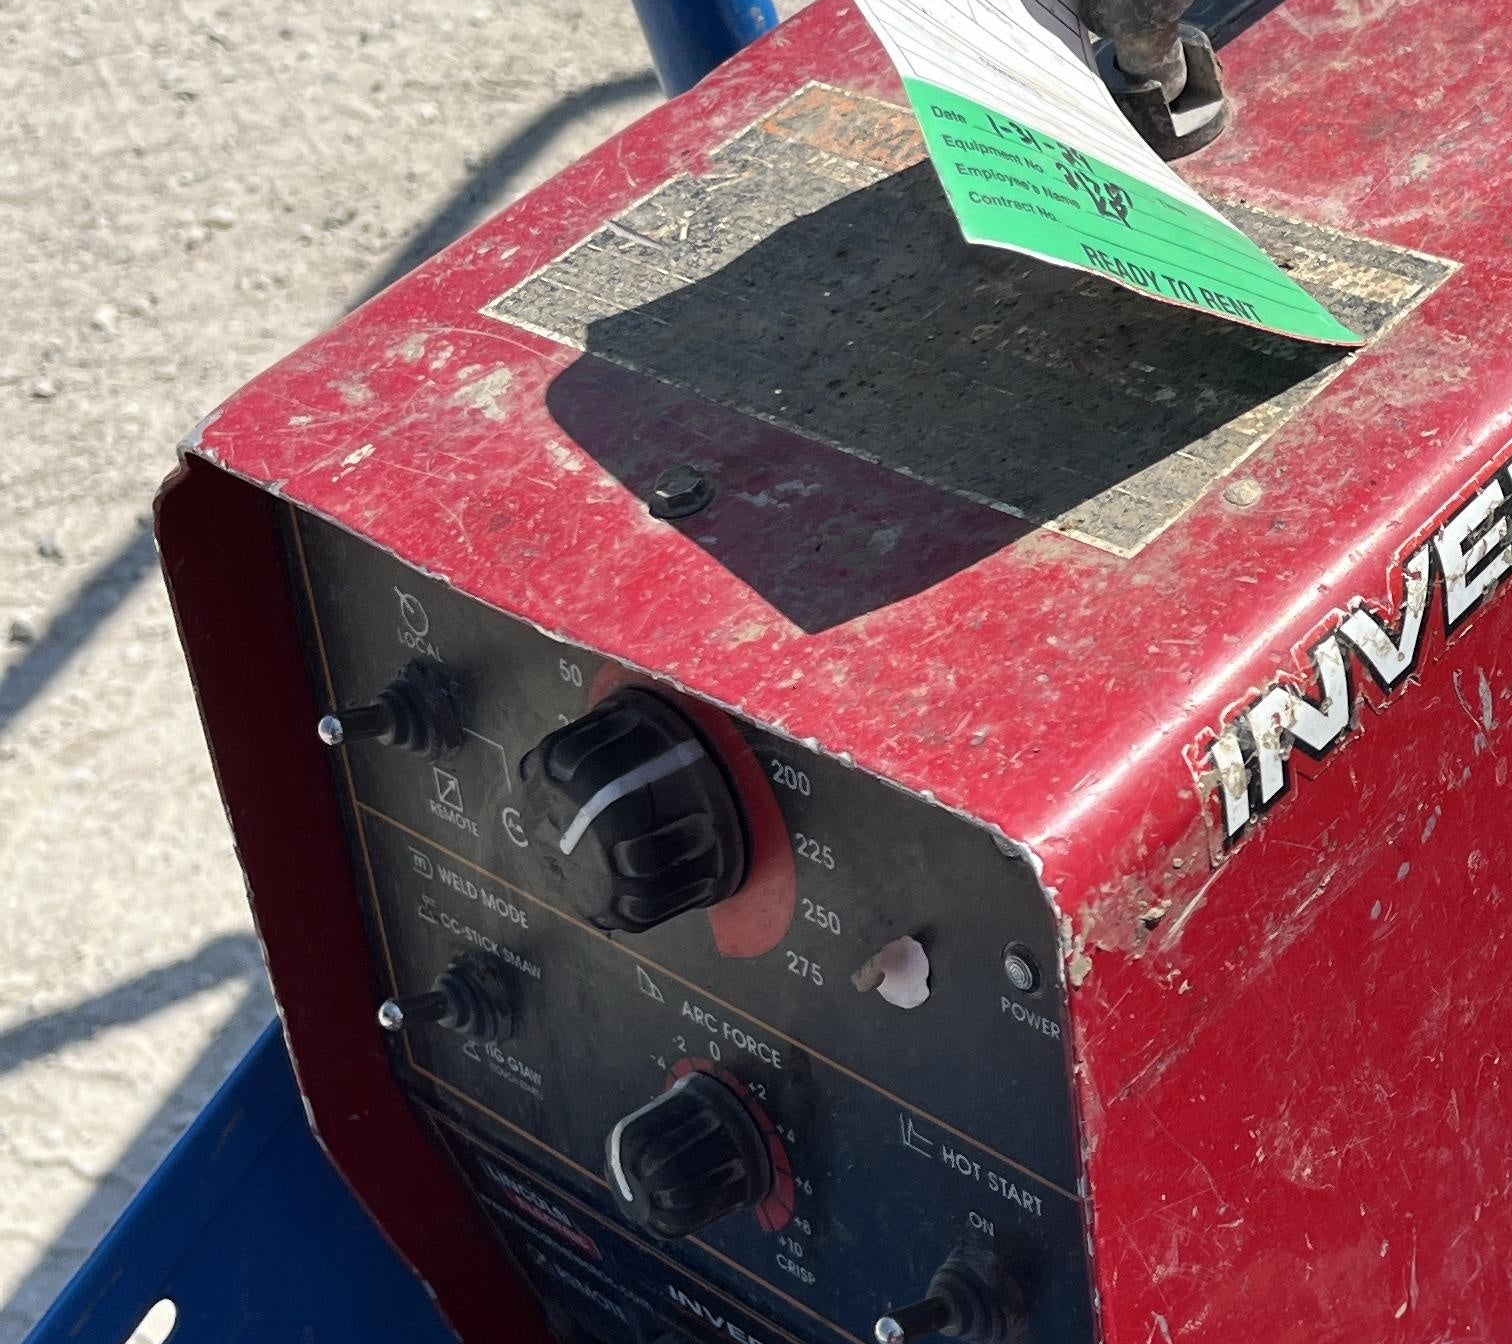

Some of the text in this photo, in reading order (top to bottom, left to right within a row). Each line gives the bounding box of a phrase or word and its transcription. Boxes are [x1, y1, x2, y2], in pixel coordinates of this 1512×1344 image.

[931, 104, 968, 126] Date
[942, 134, 1025, 168] Equipment
[956, 162, 1082, 210] Employee's Name
[968, 190, 1038, 216] Contract
[1081, 242, 1263, 324] READY TO RENT
[396, 626, 444, 664] LOCAL
[559, 658, 584, 687] 50
[770, 759, 812, 797] 200
[429, 798, 481, 838] REMOTE
[795, 832, 836, 871] 225
[438, 864, 530, 930] WELD MODE
[802, 897, 842, 936] 250
[786, 950, 825, 987] 275
[681, 1000, 784, 1070] ARC FORCE
[1000, 994, 1062, 1041] POWER
[709, 1040, 722, 1062] 0
[941, 1143, 1043, 1217] HOT START
[968, 1210, 996, 1238] ON
[778, 1235, 804, 1258] +10
[775, 1253, 817, 1286] CRISP
